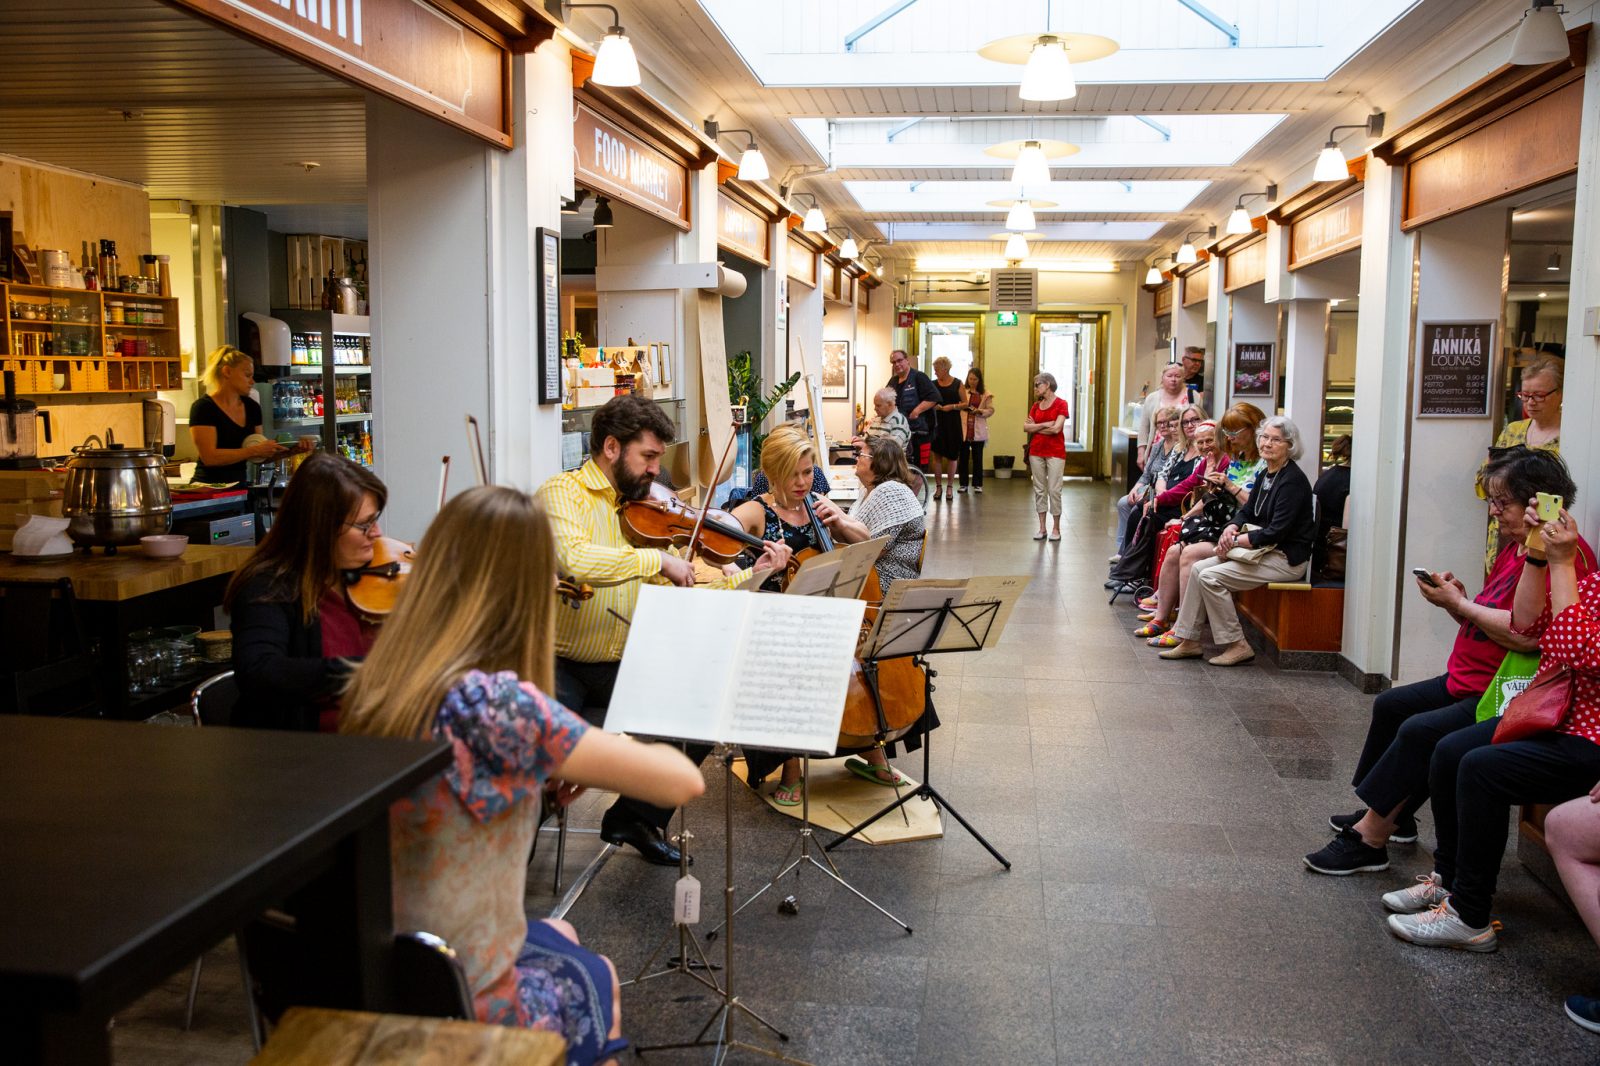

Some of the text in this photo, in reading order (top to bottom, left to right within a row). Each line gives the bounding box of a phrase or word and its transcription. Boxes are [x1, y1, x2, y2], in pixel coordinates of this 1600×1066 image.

[595, 127, 669, 202] FOOD MARKET
[1432, 339, 1481, 354] ANNIKA
[1240, 352, 1266, 360] ANNIKA
[1431, 355, 1481, 366] LOUNAS
